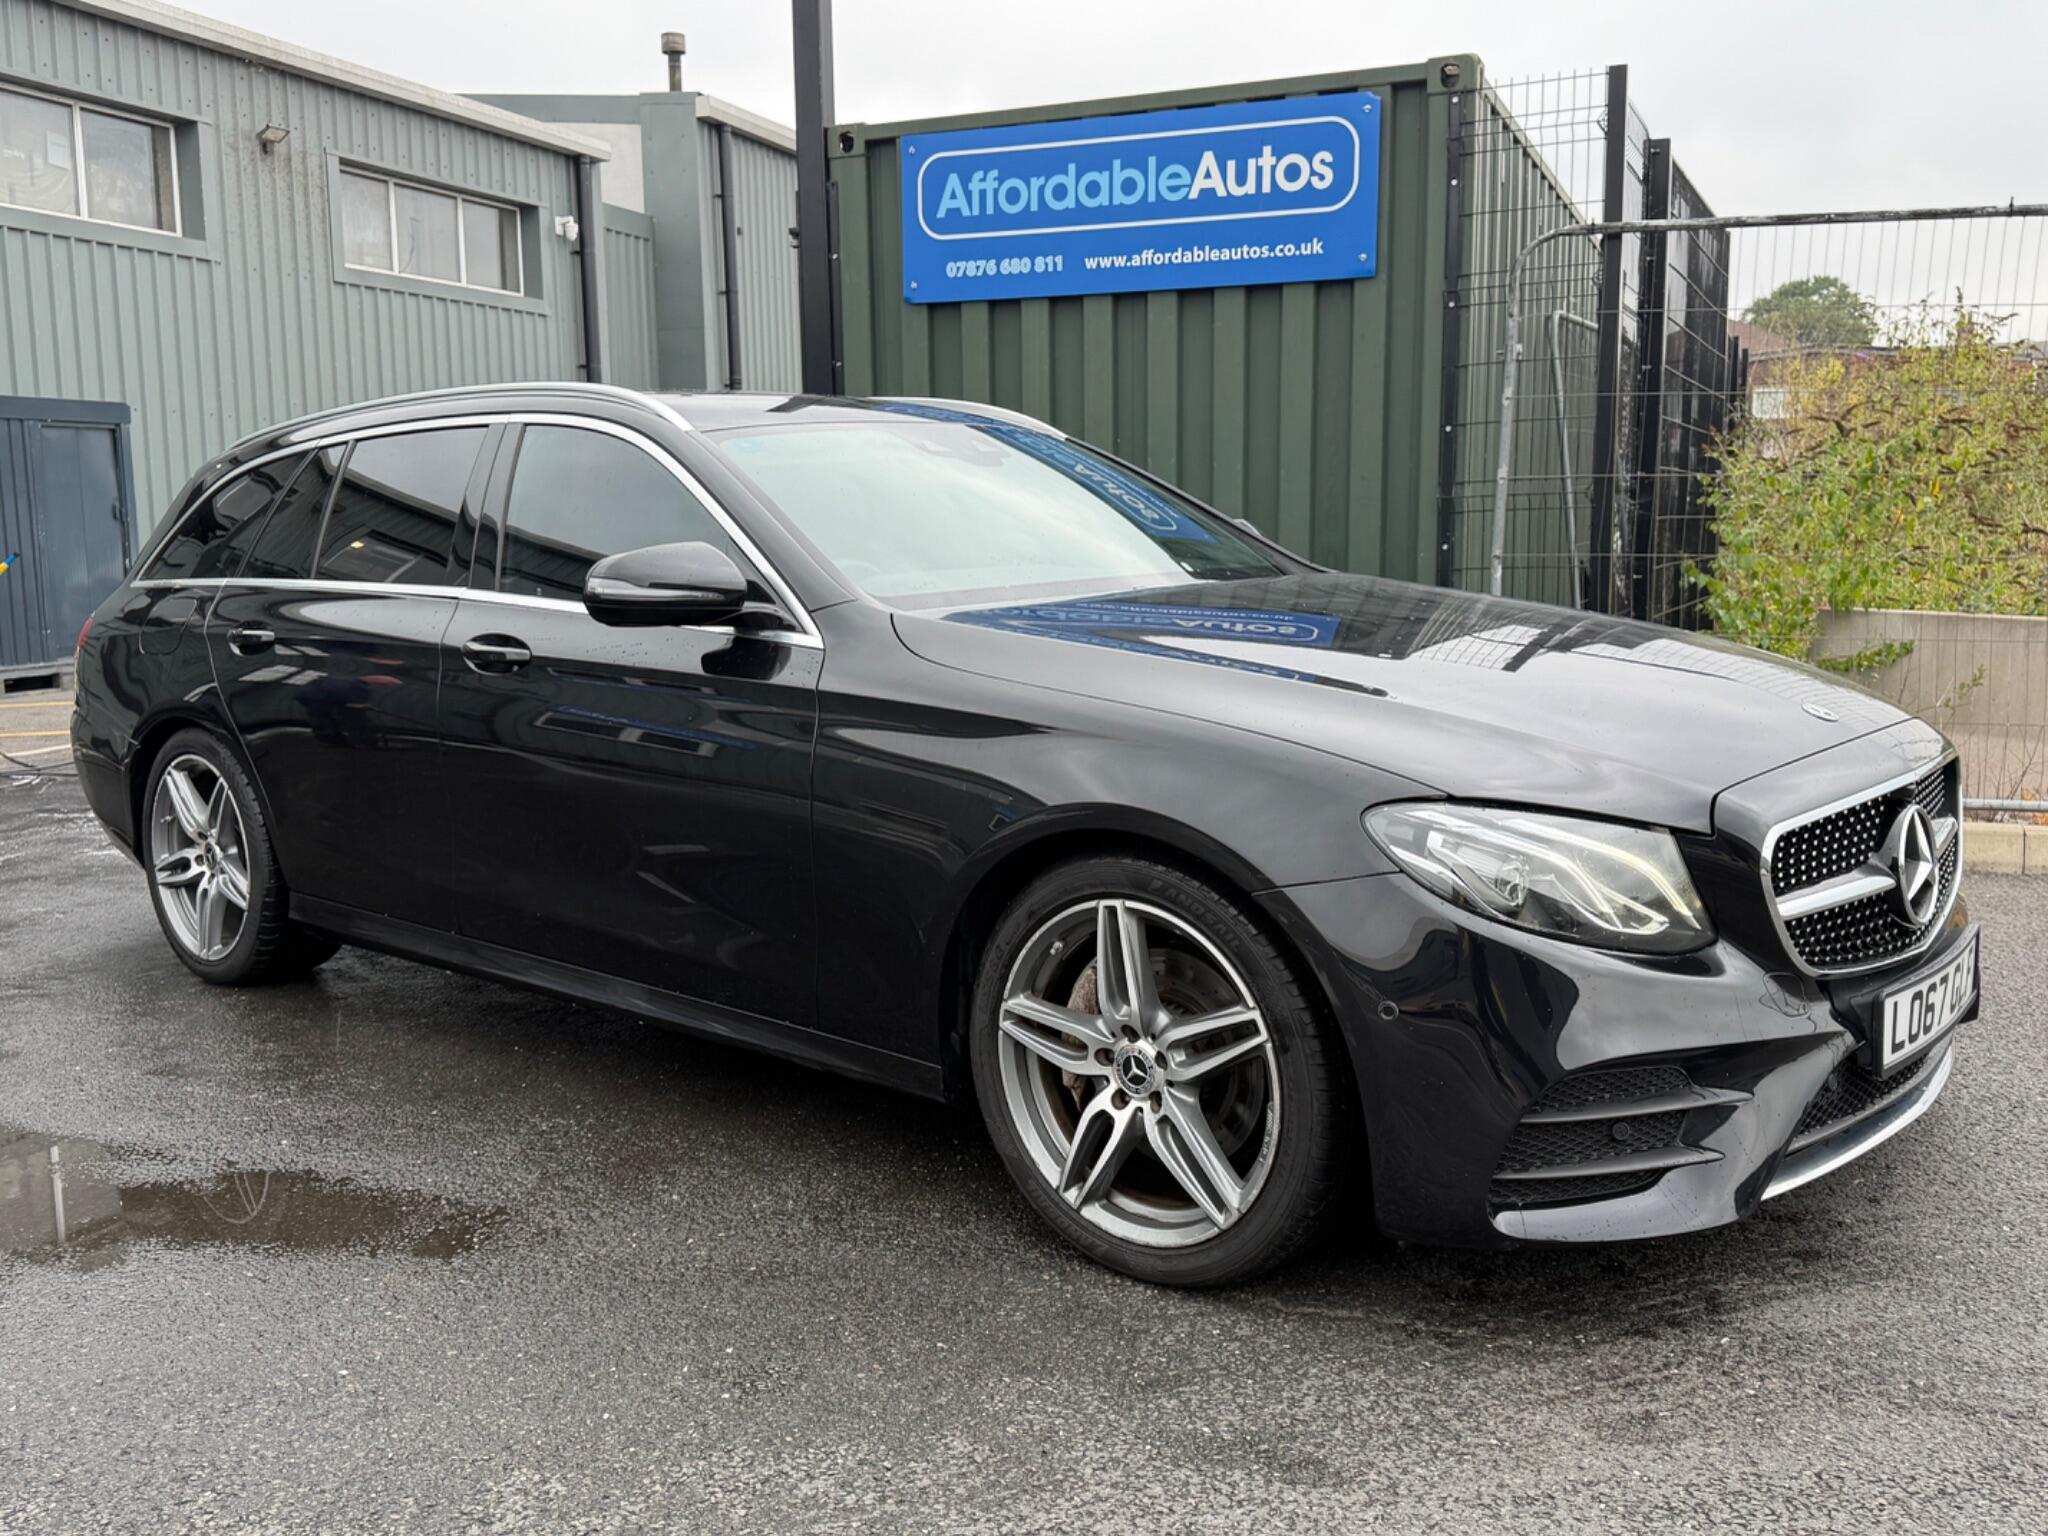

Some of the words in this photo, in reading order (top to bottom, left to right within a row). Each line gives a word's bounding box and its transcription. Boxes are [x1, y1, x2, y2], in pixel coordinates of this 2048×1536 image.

[936, 145, 1333, 218] AffordableAutos
[946, 259, 997, 278] 07876
[1000, 256, 1031, 275] 680
[1034, 254, 1063, 273] 811
[1084, 238, 1324, 269] www.affordableautos.co.uk
[1891, 972, 1950, 1055] LO67
